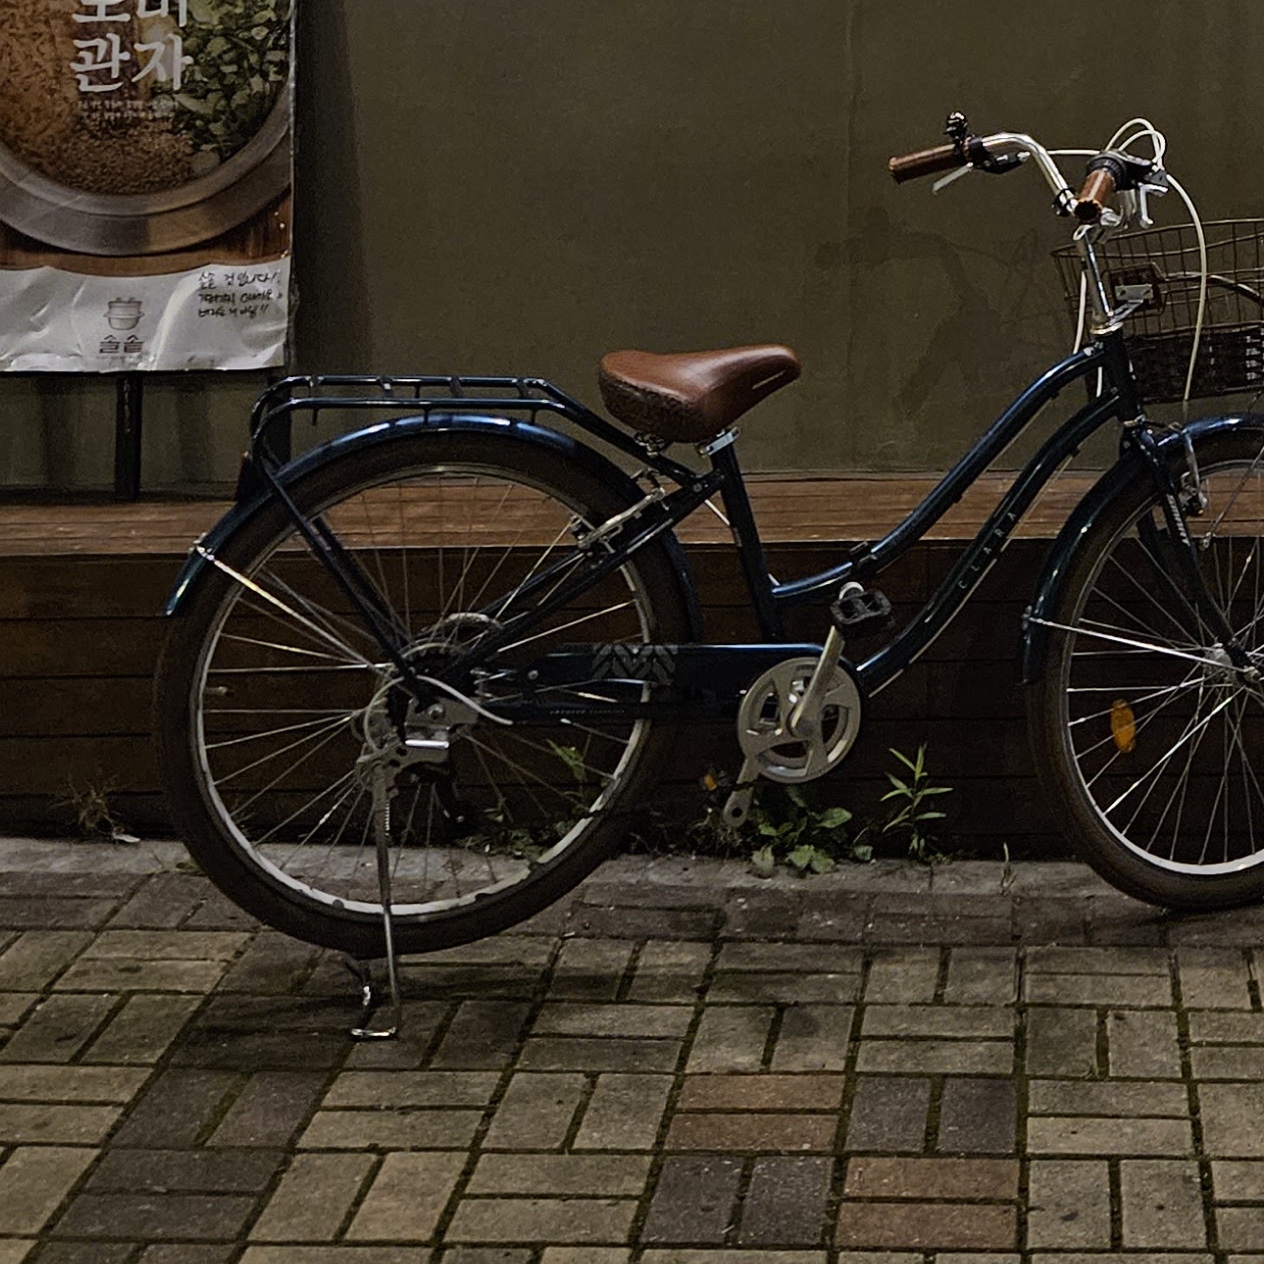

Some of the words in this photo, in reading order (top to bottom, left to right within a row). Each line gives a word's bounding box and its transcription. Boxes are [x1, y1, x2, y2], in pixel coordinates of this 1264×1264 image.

[69, 33, 194, 92] 관자
[99, 335, 144, 353] 솔솥
[957, 512, 1016, 589] CLARA
